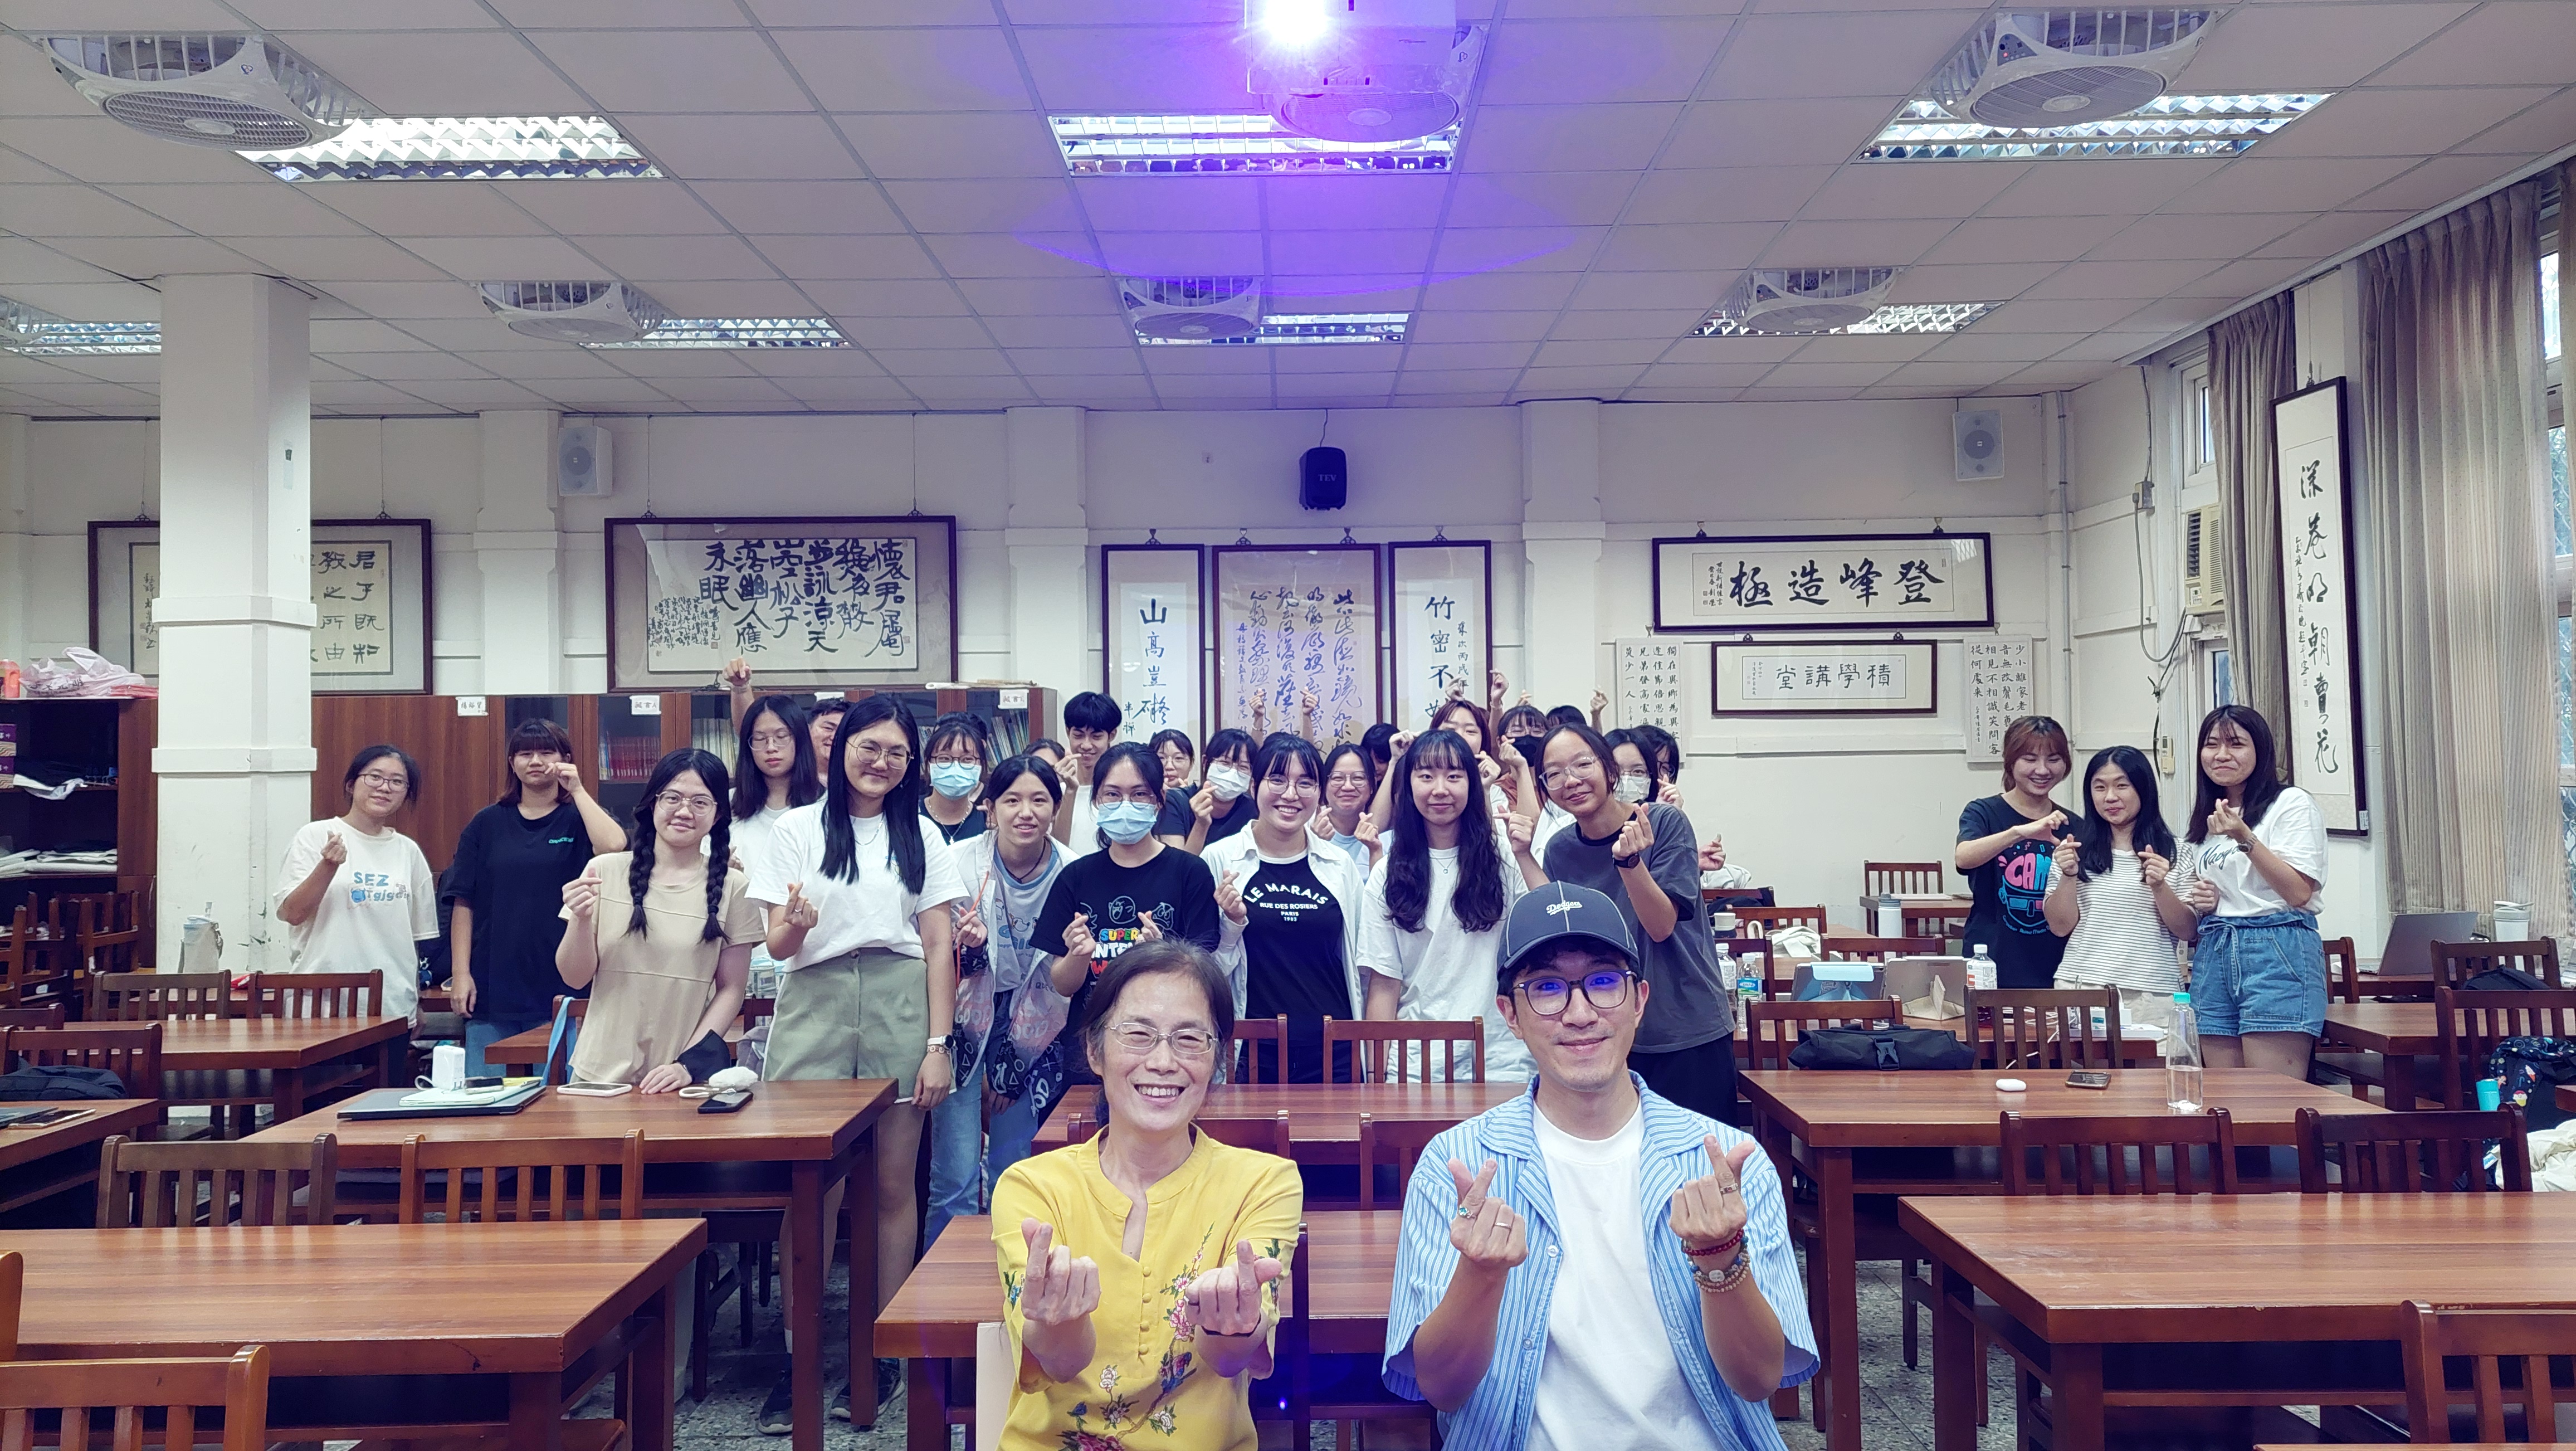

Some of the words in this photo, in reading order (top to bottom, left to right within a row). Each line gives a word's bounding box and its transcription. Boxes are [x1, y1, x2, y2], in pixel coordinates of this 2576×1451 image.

[1729, 557, 1944, 608] 登峰造極
[1132, 598, 1170, 736] 山高豈礙
[1776, 663, 1891, 690] 積學講堂
[2015, 644, 2028, 718] 少小離家老
[1985, 644, 2001, 754] 相見不相識笑問客
[1999, 644, 2014, 734] 音無改鬢毛衰
[354, 871, 389, 887] SEZ
[1243, 887, 1264, 903] LE
[1265, 883, 1328, 904] MARAIS
[1546, 900, 1583, 916] Dodgers
[1100, 929, 1139, 941] SUPER
